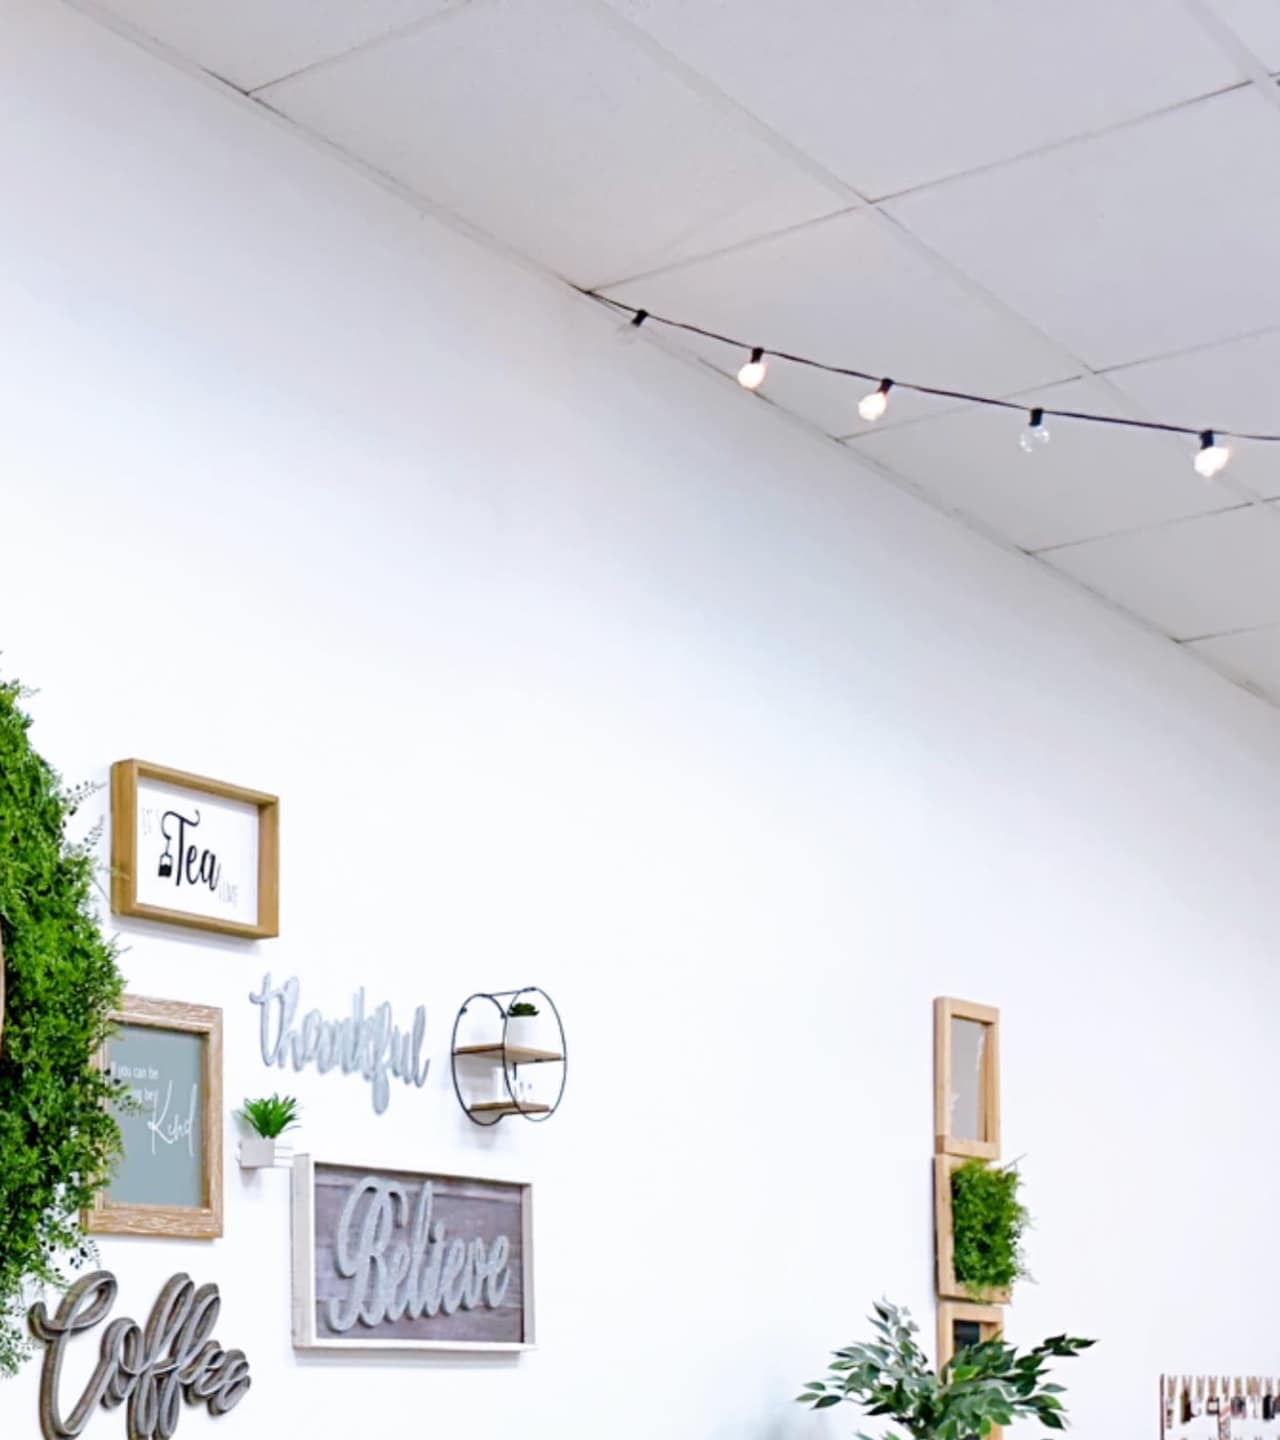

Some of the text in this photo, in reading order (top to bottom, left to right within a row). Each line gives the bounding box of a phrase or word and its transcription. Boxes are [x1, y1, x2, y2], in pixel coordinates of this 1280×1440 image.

[160, 808, 221, 892] Tea
[248, 970, 431, 1116] thankful
[146, 1079, 198, 1158] Kind
[327, 1175, 514, 1334] Believe
